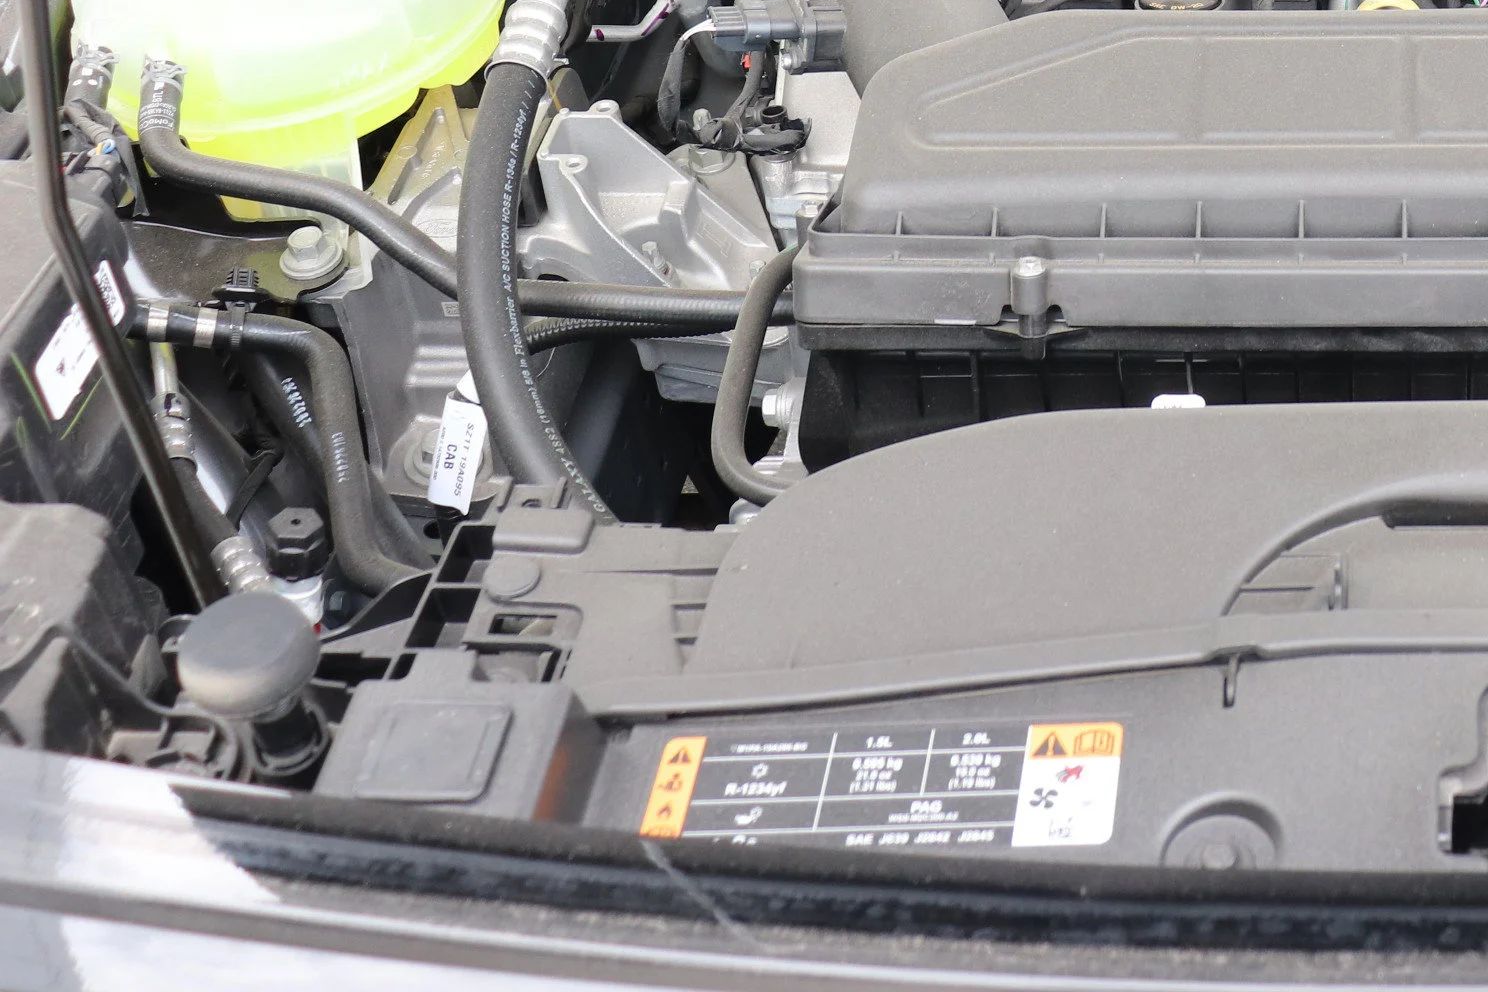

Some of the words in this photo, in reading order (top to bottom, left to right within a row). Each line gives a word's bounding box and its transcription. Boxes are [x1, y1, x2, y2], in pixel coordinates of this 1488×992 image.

[510, 108, 527, 152] R-1234yf
[504, 158, 517, 192] R-134a
[502, 193, 513, 223] HOSE
[501, 225, 511, 272] SUCTION
[502, 274, 512, 292] A/C
[443, 444, 458, 470] CAB
[560, 457, 605, 512] GALAXY
[724, 780, 788, 797] R-1234yf
[910, 800, 943, 814] PAG
[845, 832, 874, 847] SAE
